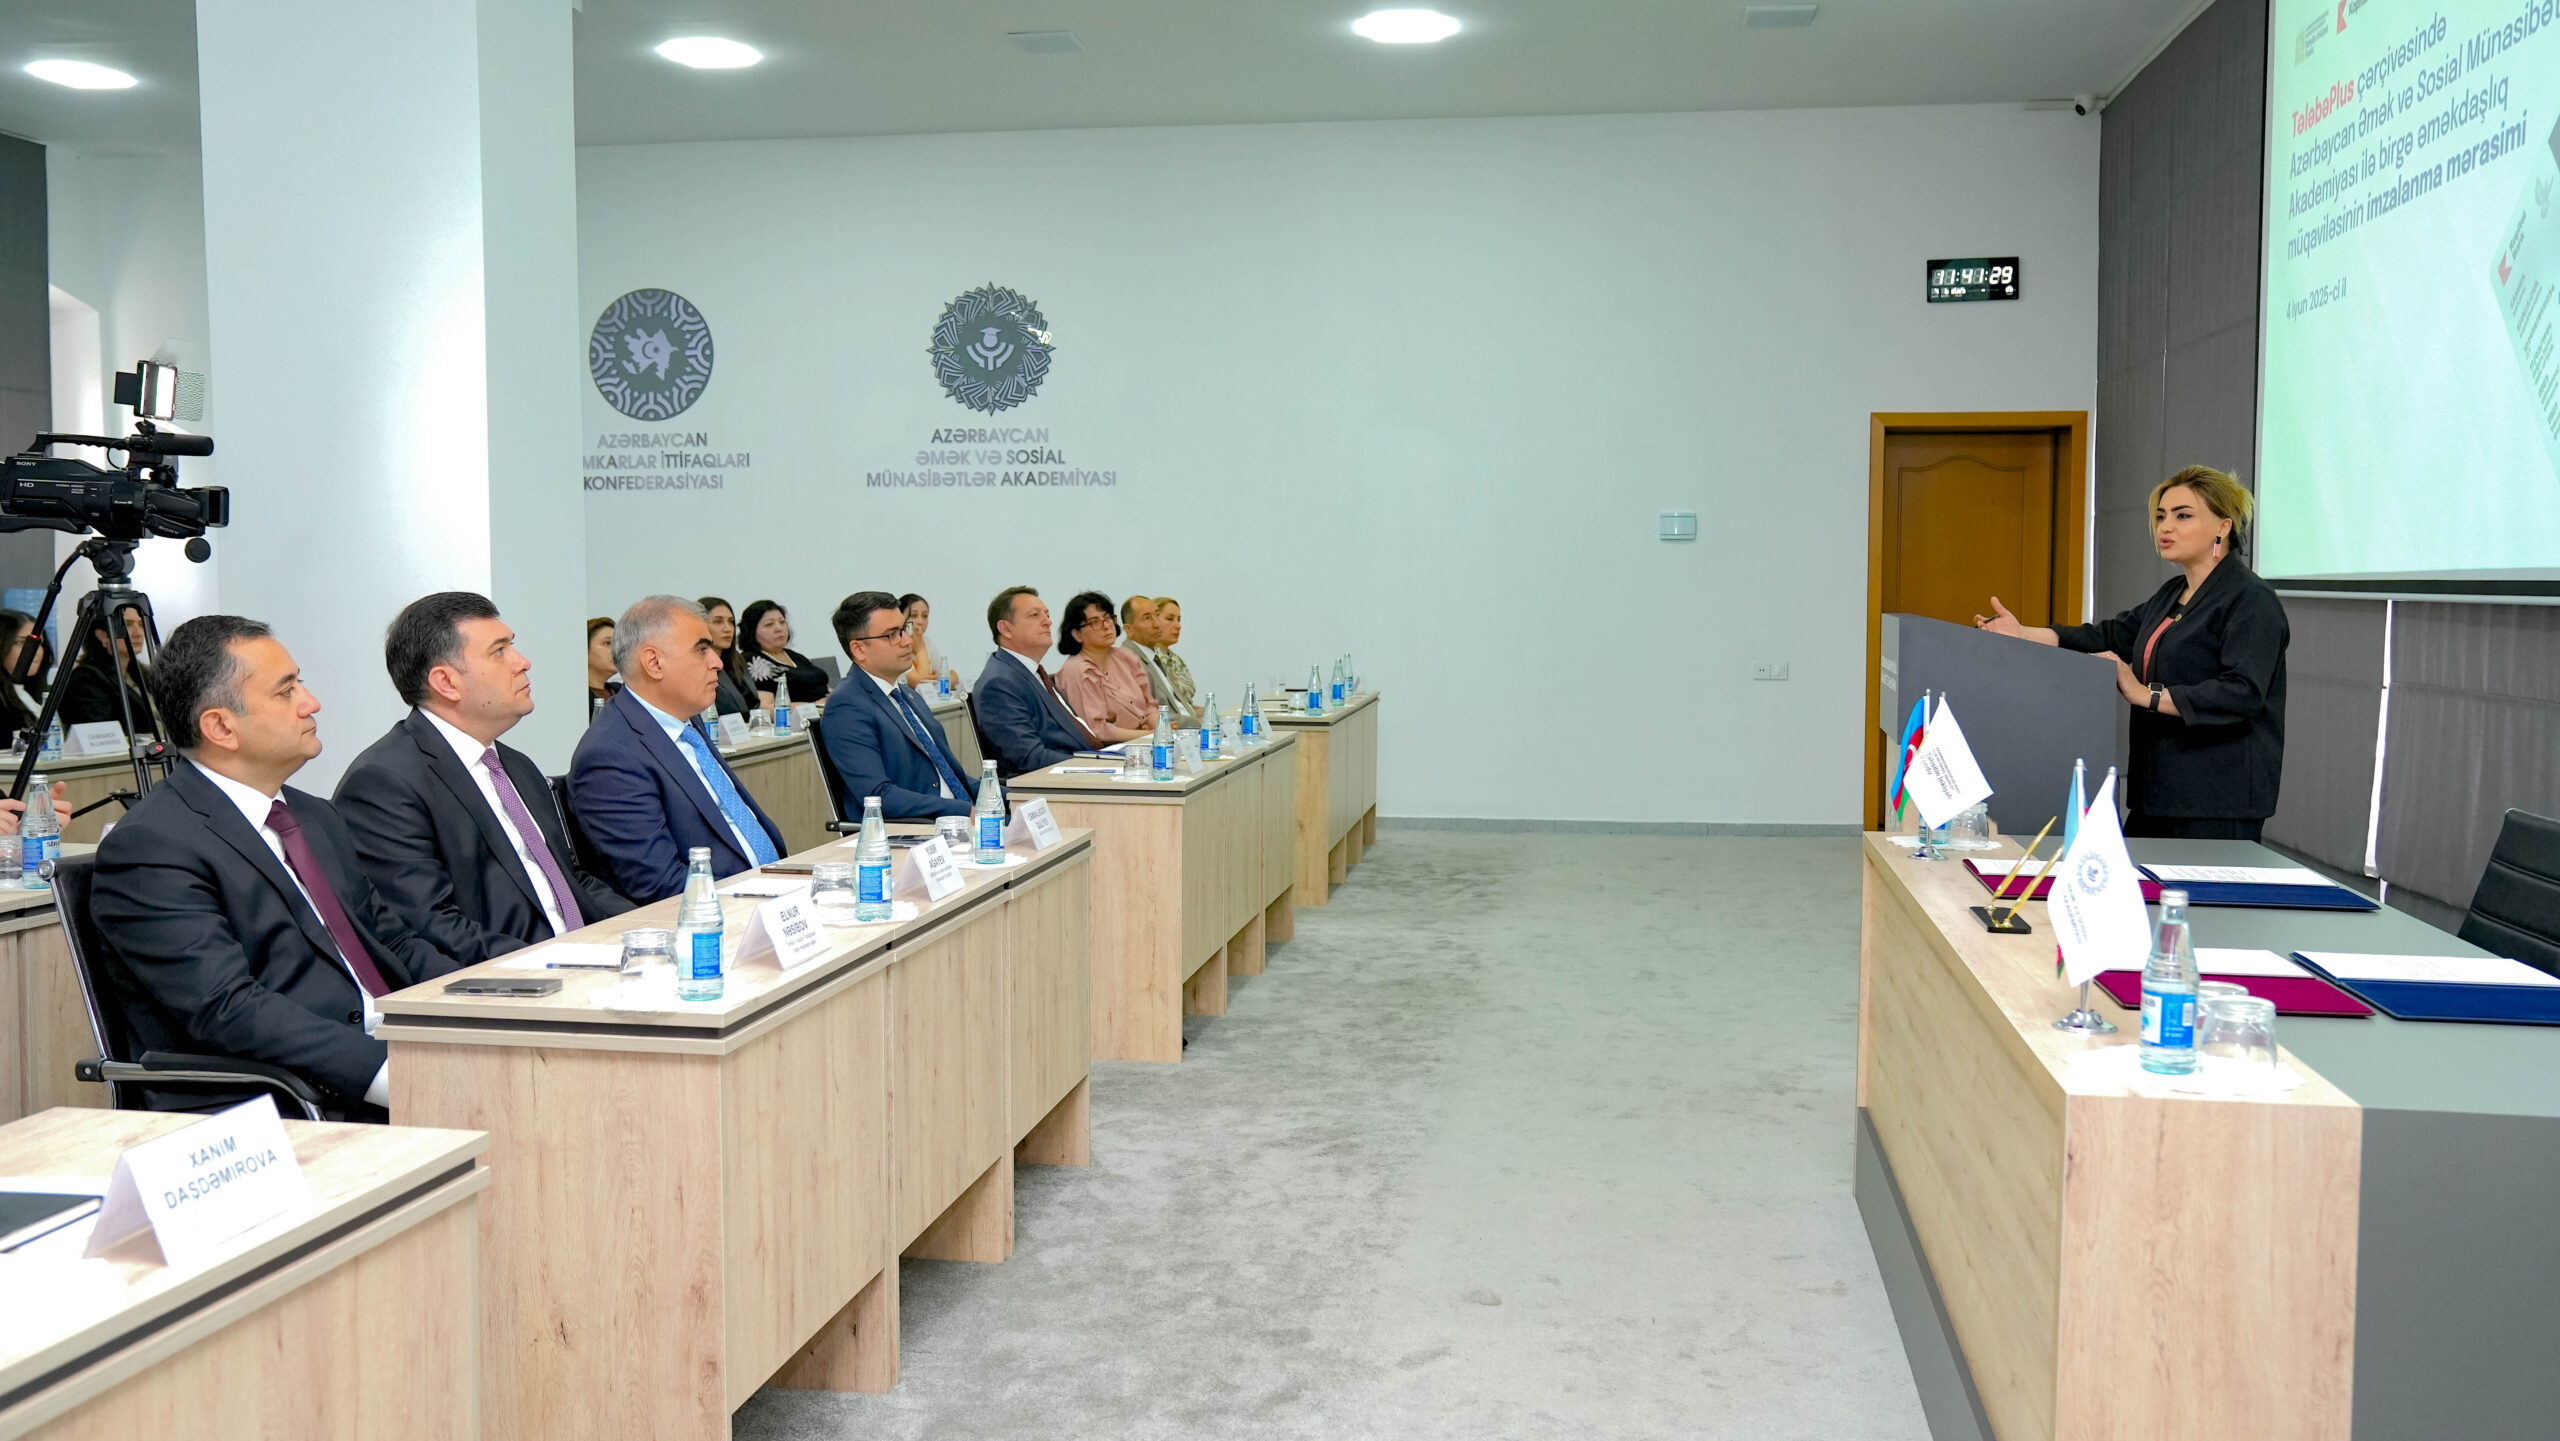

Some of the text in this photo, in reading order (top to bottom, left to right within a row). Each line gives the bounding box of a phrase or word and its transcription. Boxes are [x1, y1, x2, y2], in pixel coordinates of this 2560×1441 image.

[2292, 12, 2446, 138] TələbəPlus çərçivəsində
[2289, 121, 2355, 180] Azərbaycan
[2358, 90, 2395, 138] Əmək
[2398, 86, 2413, 114] və
[2417, 43, 2462, 102] Sosial
[2288, 74, 2509, 221] Akademiyası ilə birgə əməkdaşlıq
[2288, 109, 2527, 261] müqaviləsinin imzalanma mərasimi
[1935, 266, 2014, 286] 11:41:29
[2286, 276, 2347, 324] 4 iyun 2025-ci il
[597, 432, 708, 449] AZƏRBAYCAN
[931, 427, 1050, 444] AZƏRBAYCAN
[582, 450, 750, 470] MKARLAR İTTİFAQLARI
[915, 446, 1066, 466] ƏMƏK VƏ SOSİAL
[583, 472, 723, 491] KONFEDERASİYASI
[866, 467, 1117, 488] MÜNASİBƏTLƏR AKADEMİYASI
[780, 906, 800, 922] ELNUR
[188, 1136, 237, 1168] XANIM
